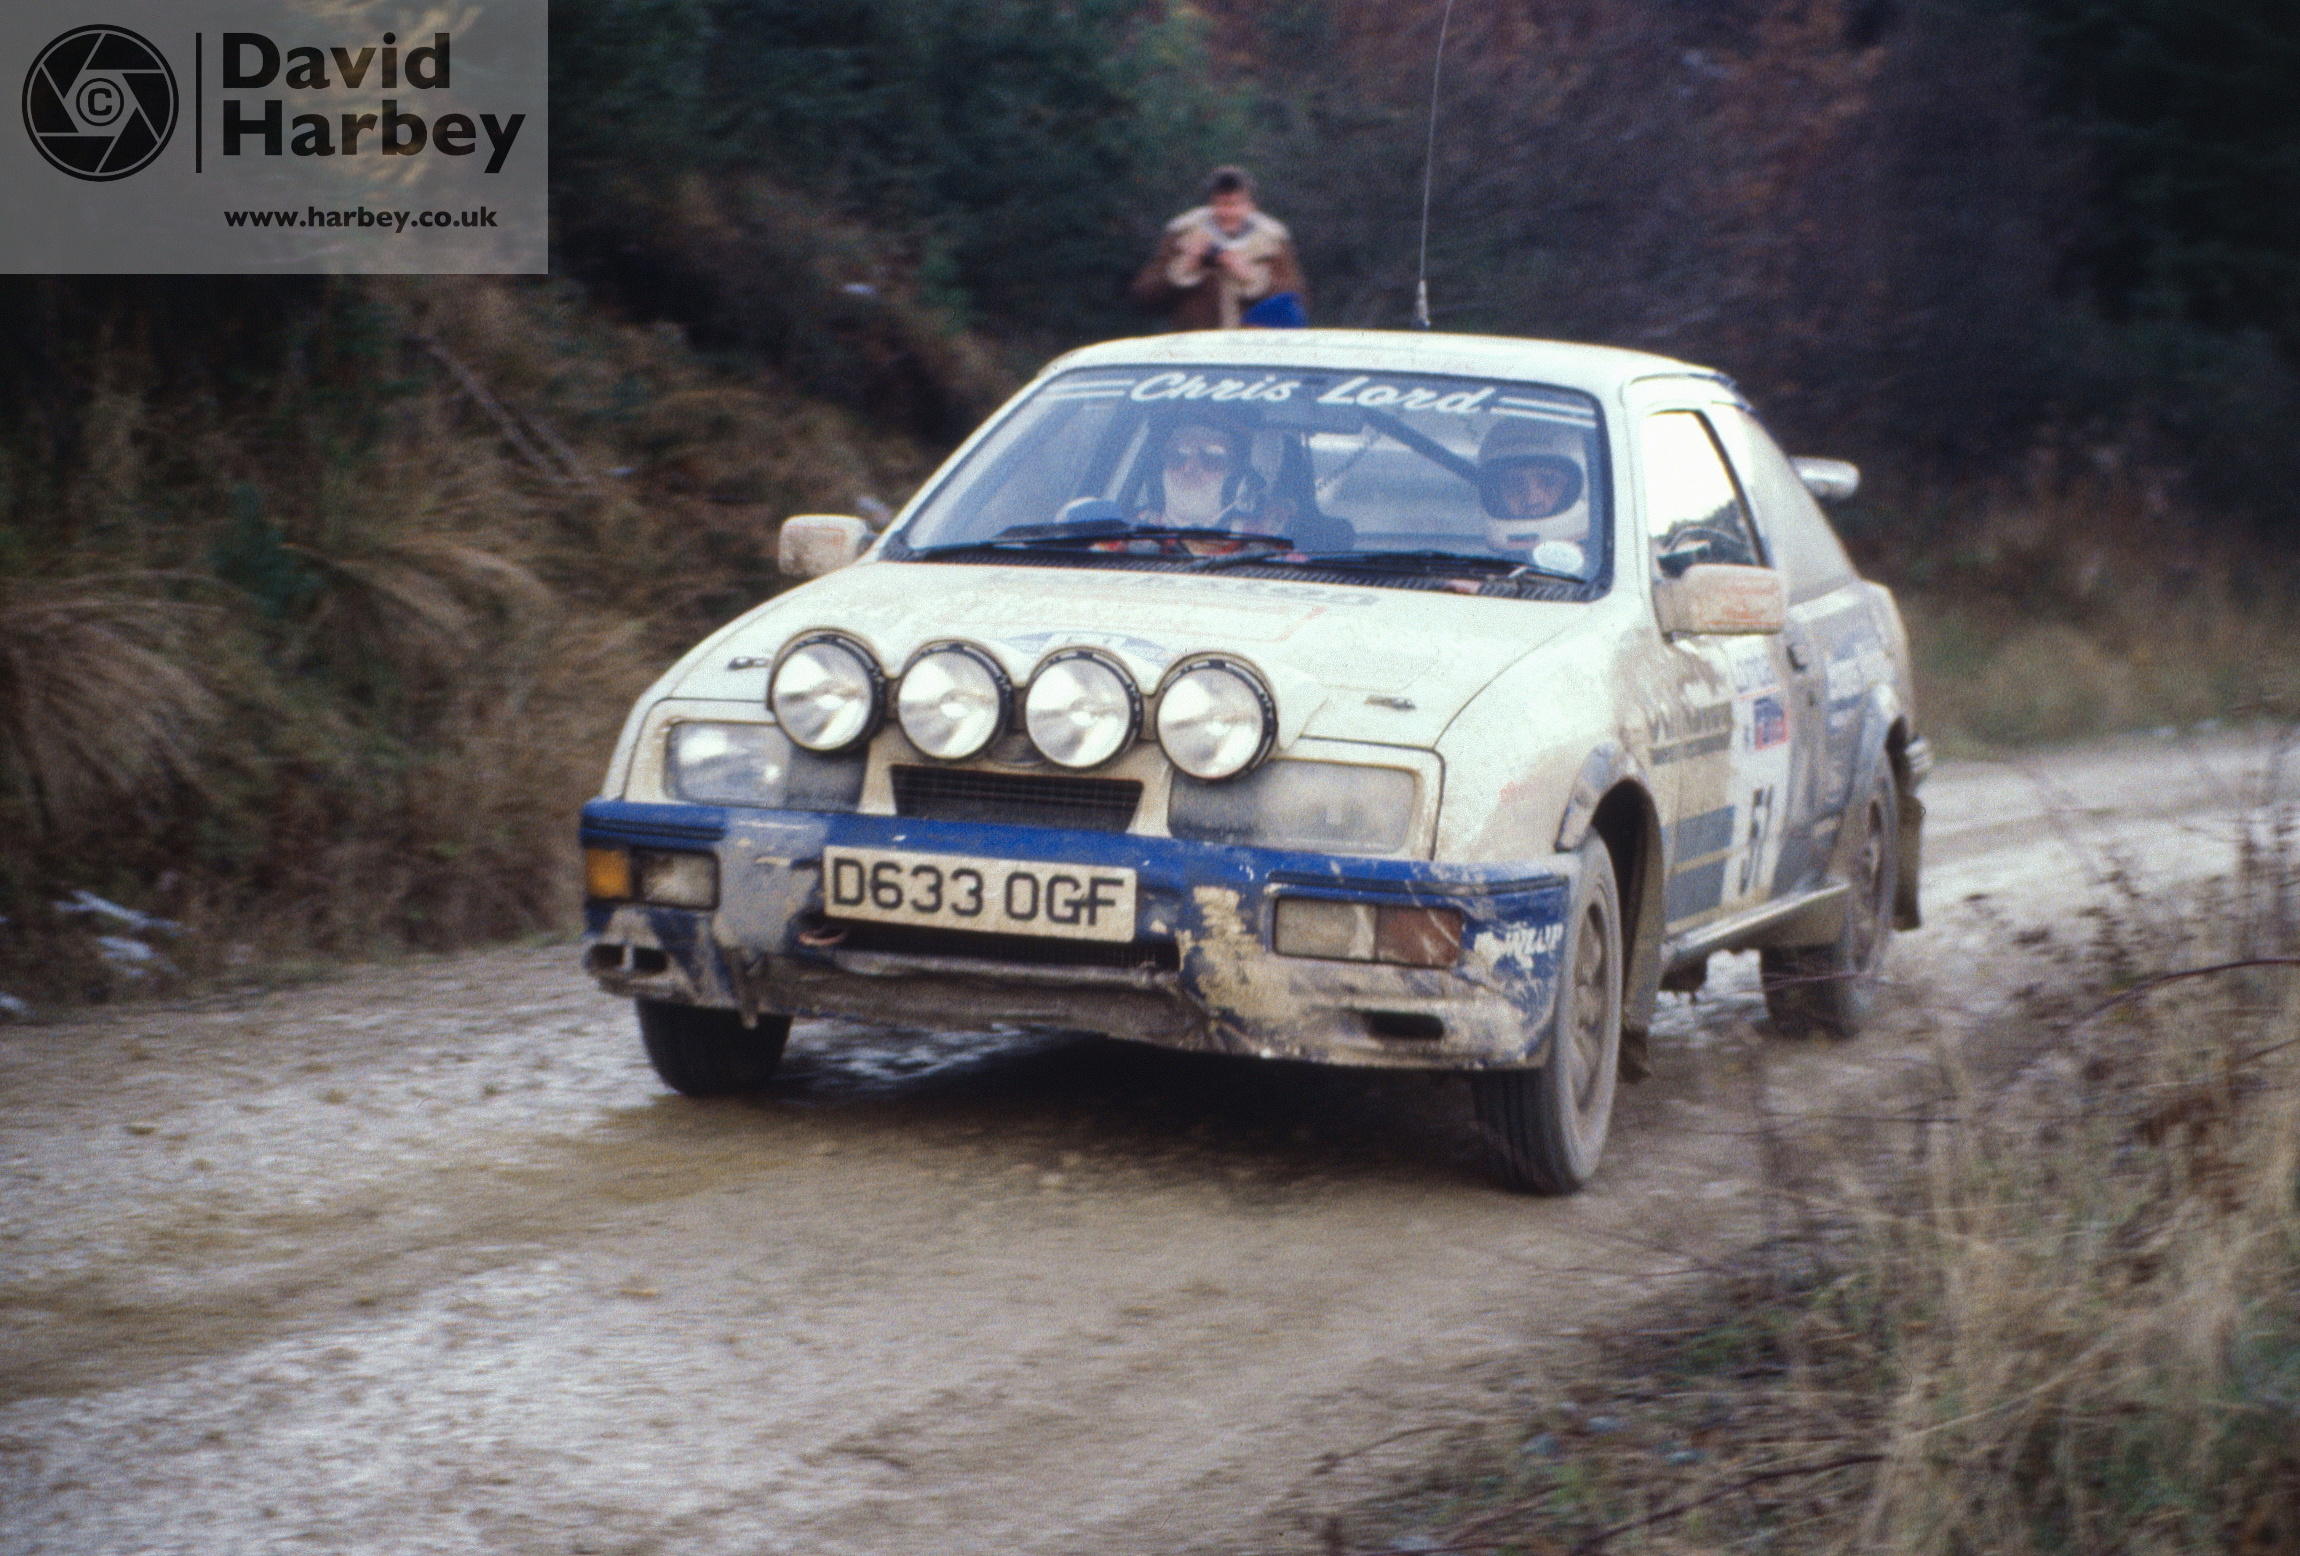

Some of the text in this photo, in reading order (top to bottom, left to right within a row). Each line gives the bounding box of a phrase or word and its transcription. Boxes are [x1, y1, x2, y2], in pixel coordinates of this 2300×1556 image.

[1131, 371, 1496, 415] Chris Lord
[832, 857, 1125, 926] D633 OGF
